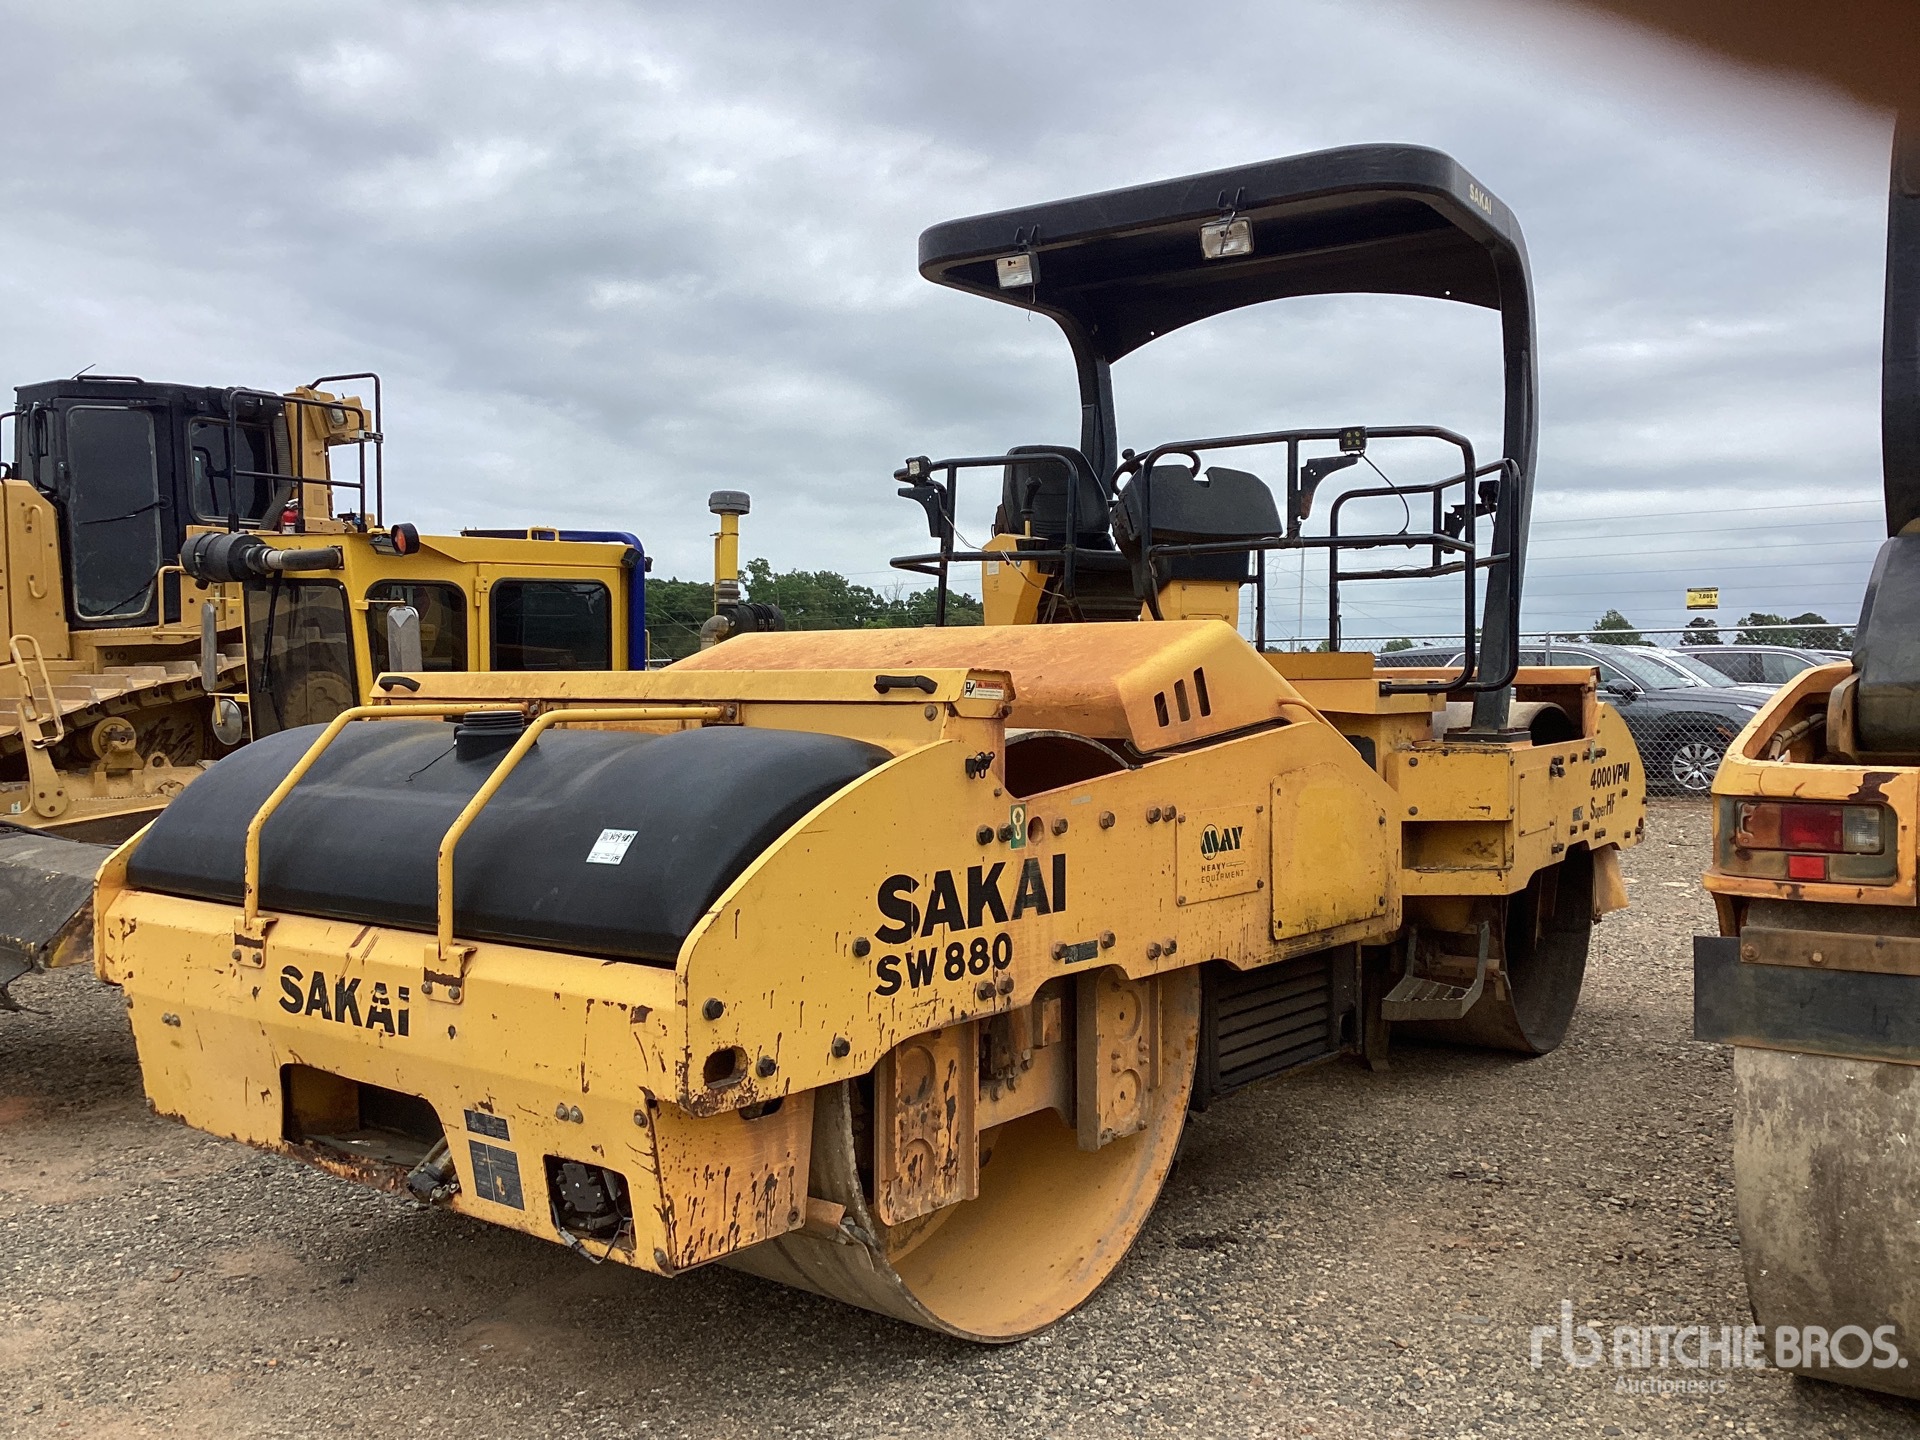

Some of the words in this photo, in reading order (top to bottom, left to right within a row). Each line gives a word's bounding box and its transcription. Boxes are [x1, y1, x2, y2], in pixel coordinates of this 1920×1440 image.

[1469, 183, 1492, 215] SAKAI
[1201, 826, 1243, 855] MAY
[1201, 862, 1226, 872] HEAVY
[1201, 869, 1244, 884] EQUIPMENT
[874, 853, 1067, 945] SAKAI
[278, 965, 410, 1037] SAKAI
